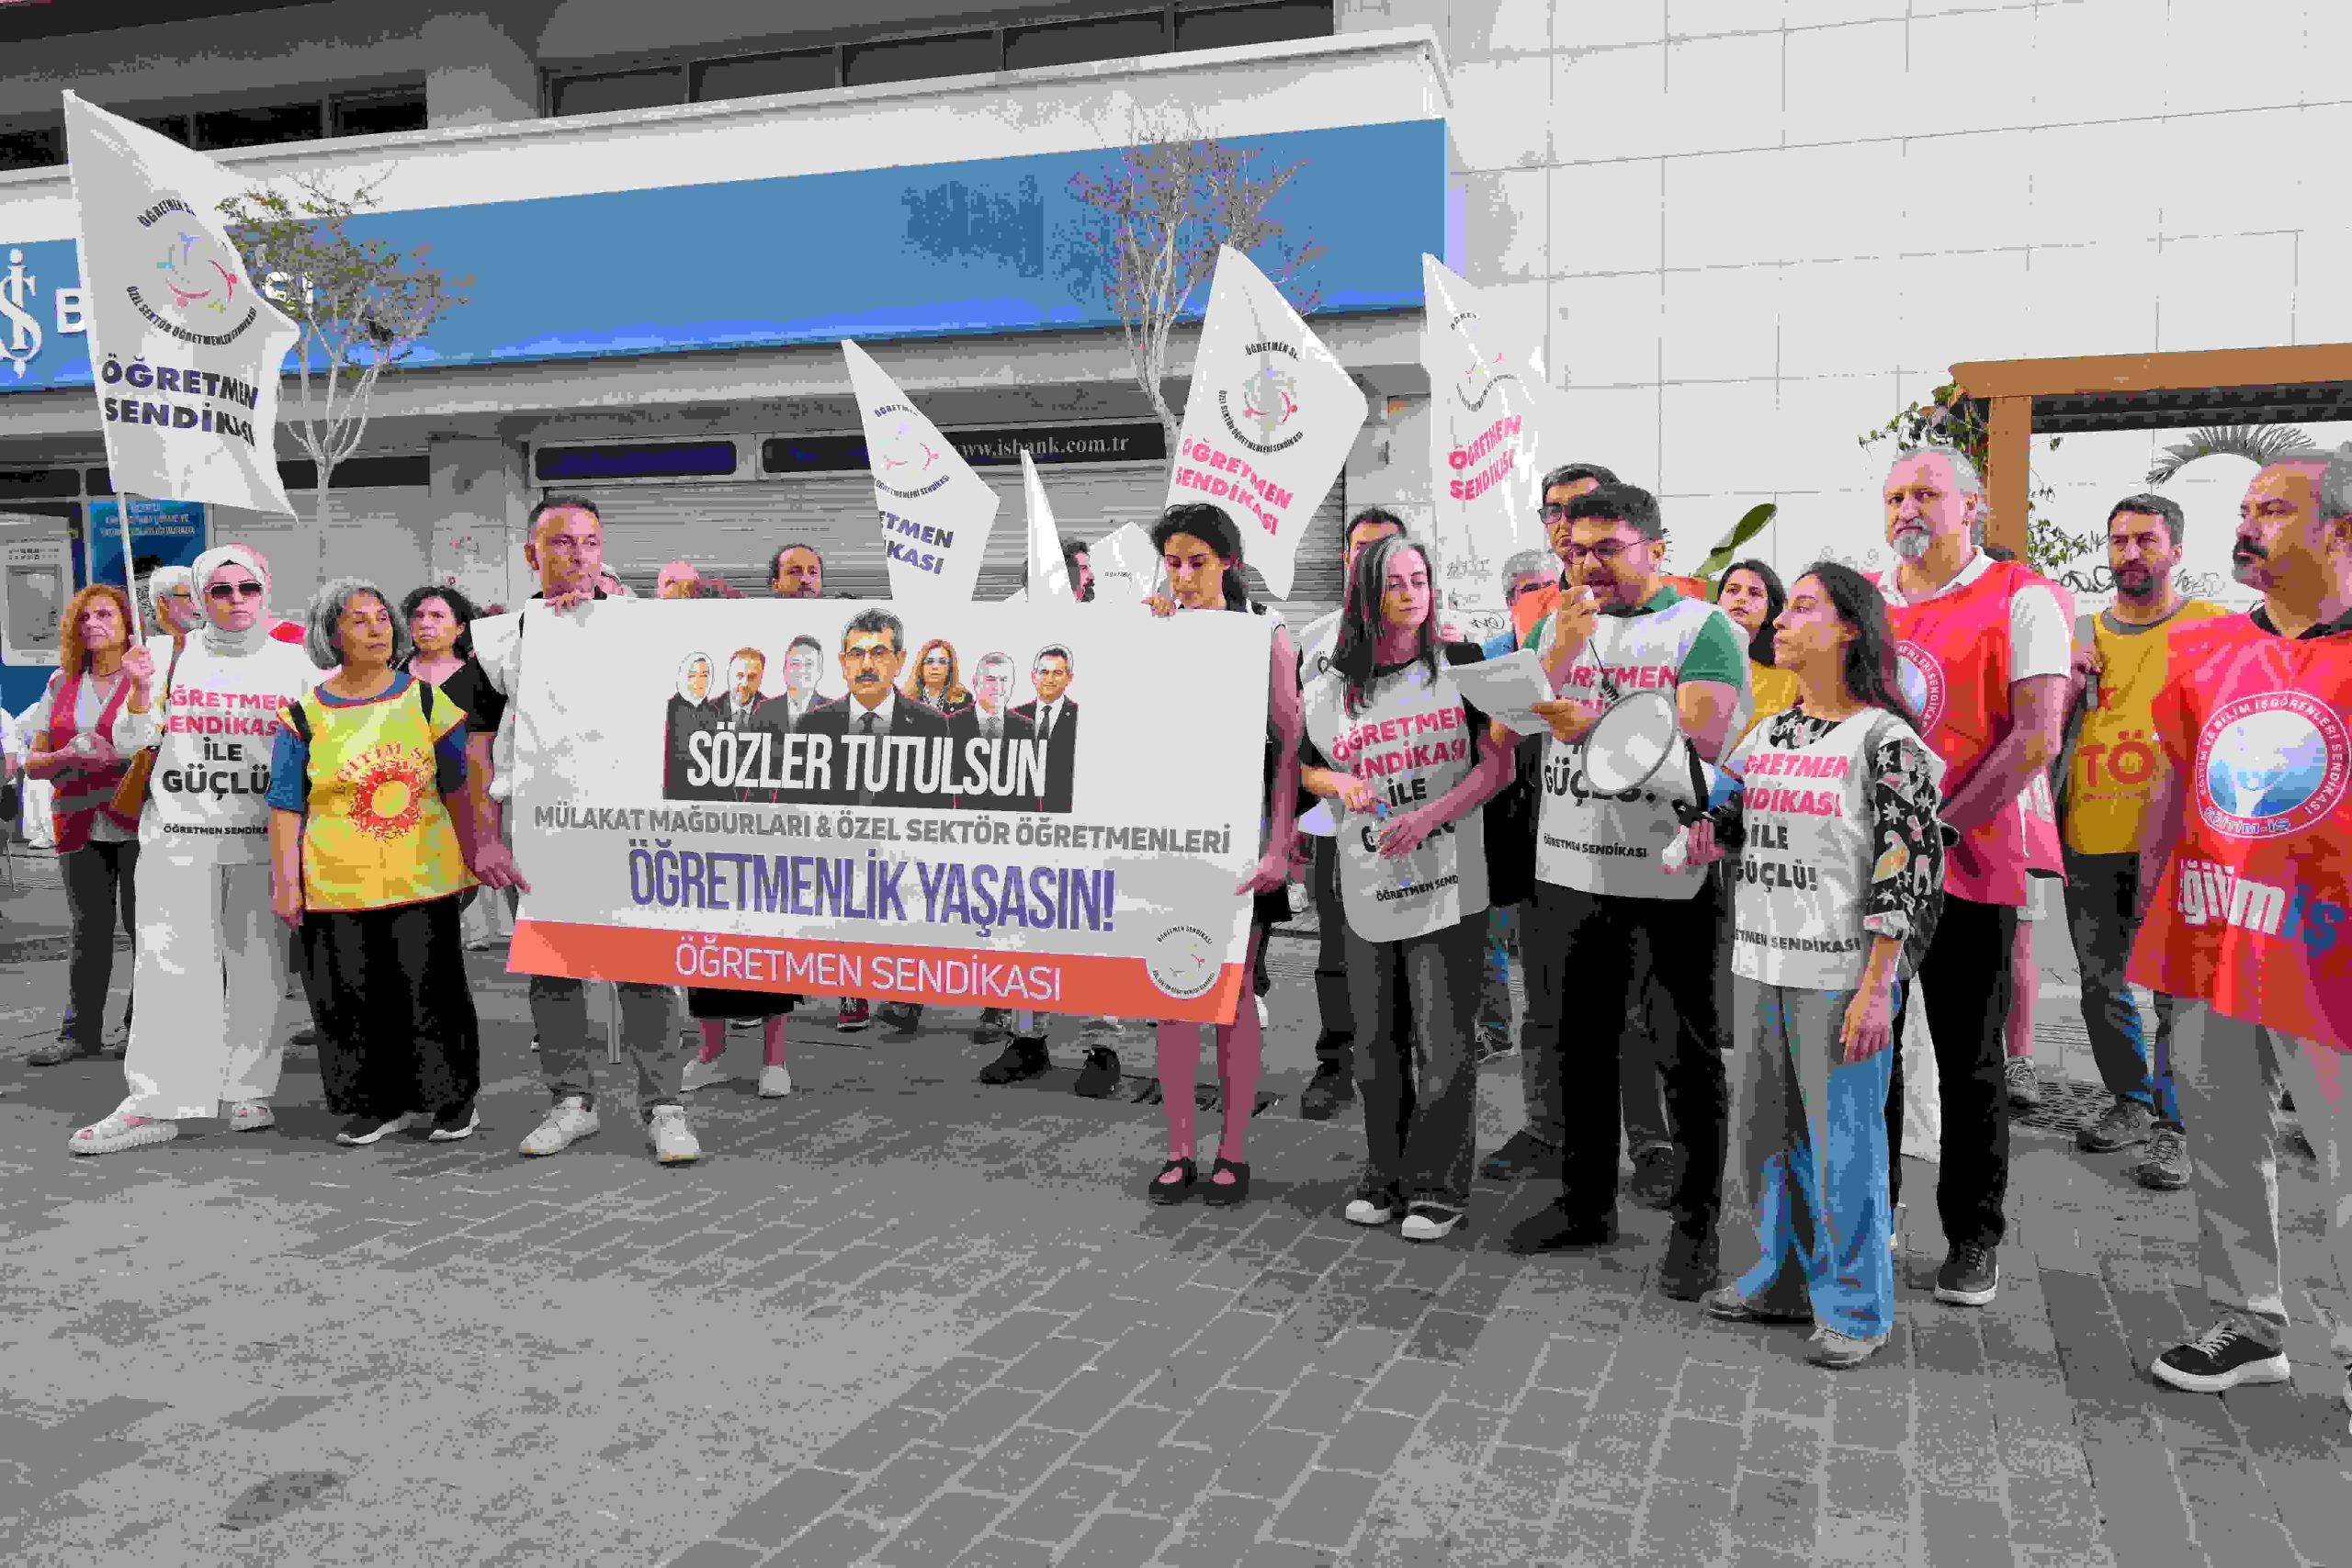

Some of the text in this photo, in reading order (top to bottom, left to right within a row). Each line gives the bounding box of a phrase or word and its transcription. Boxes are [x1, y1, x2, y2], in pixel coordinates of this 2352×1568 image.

[102, 353, 259, 410] ÖĞRETMEN
[952, 436, 1129, 457] ww.isbank.com.tr
[165, 710, 278, 736] ENDİKAS
[203, 737, 242, 761] İLE
[687, 722, 1047, 798] SÖZLER TUTULSUN
[1386, 777, 1427, 807] İLE
[2304, 743, 2343, 815] SENDİKASI
[164, 823, 268, 835] ÖĞRETMEN SENDİKA
[535, 801, 1231, 854] MÜLAKAT MAĞDURLARI & ÖZEL SEKTÖR ÖĞRETMENLERİ
[1750, 816, 1788, 850] İLE
[1582, 842, 1647, 858] SENDİKASI
[629, 839, 1115, 938] ÖĞRETMENLİK YAŞASIN!
[1376, 881, 1434, 901] ÖĞRETMEN
[1771, 935, 1861, 953] SENDİKASI
[676, 934, 1062, 1001] ÖĞRETMEN SENDİKASI
